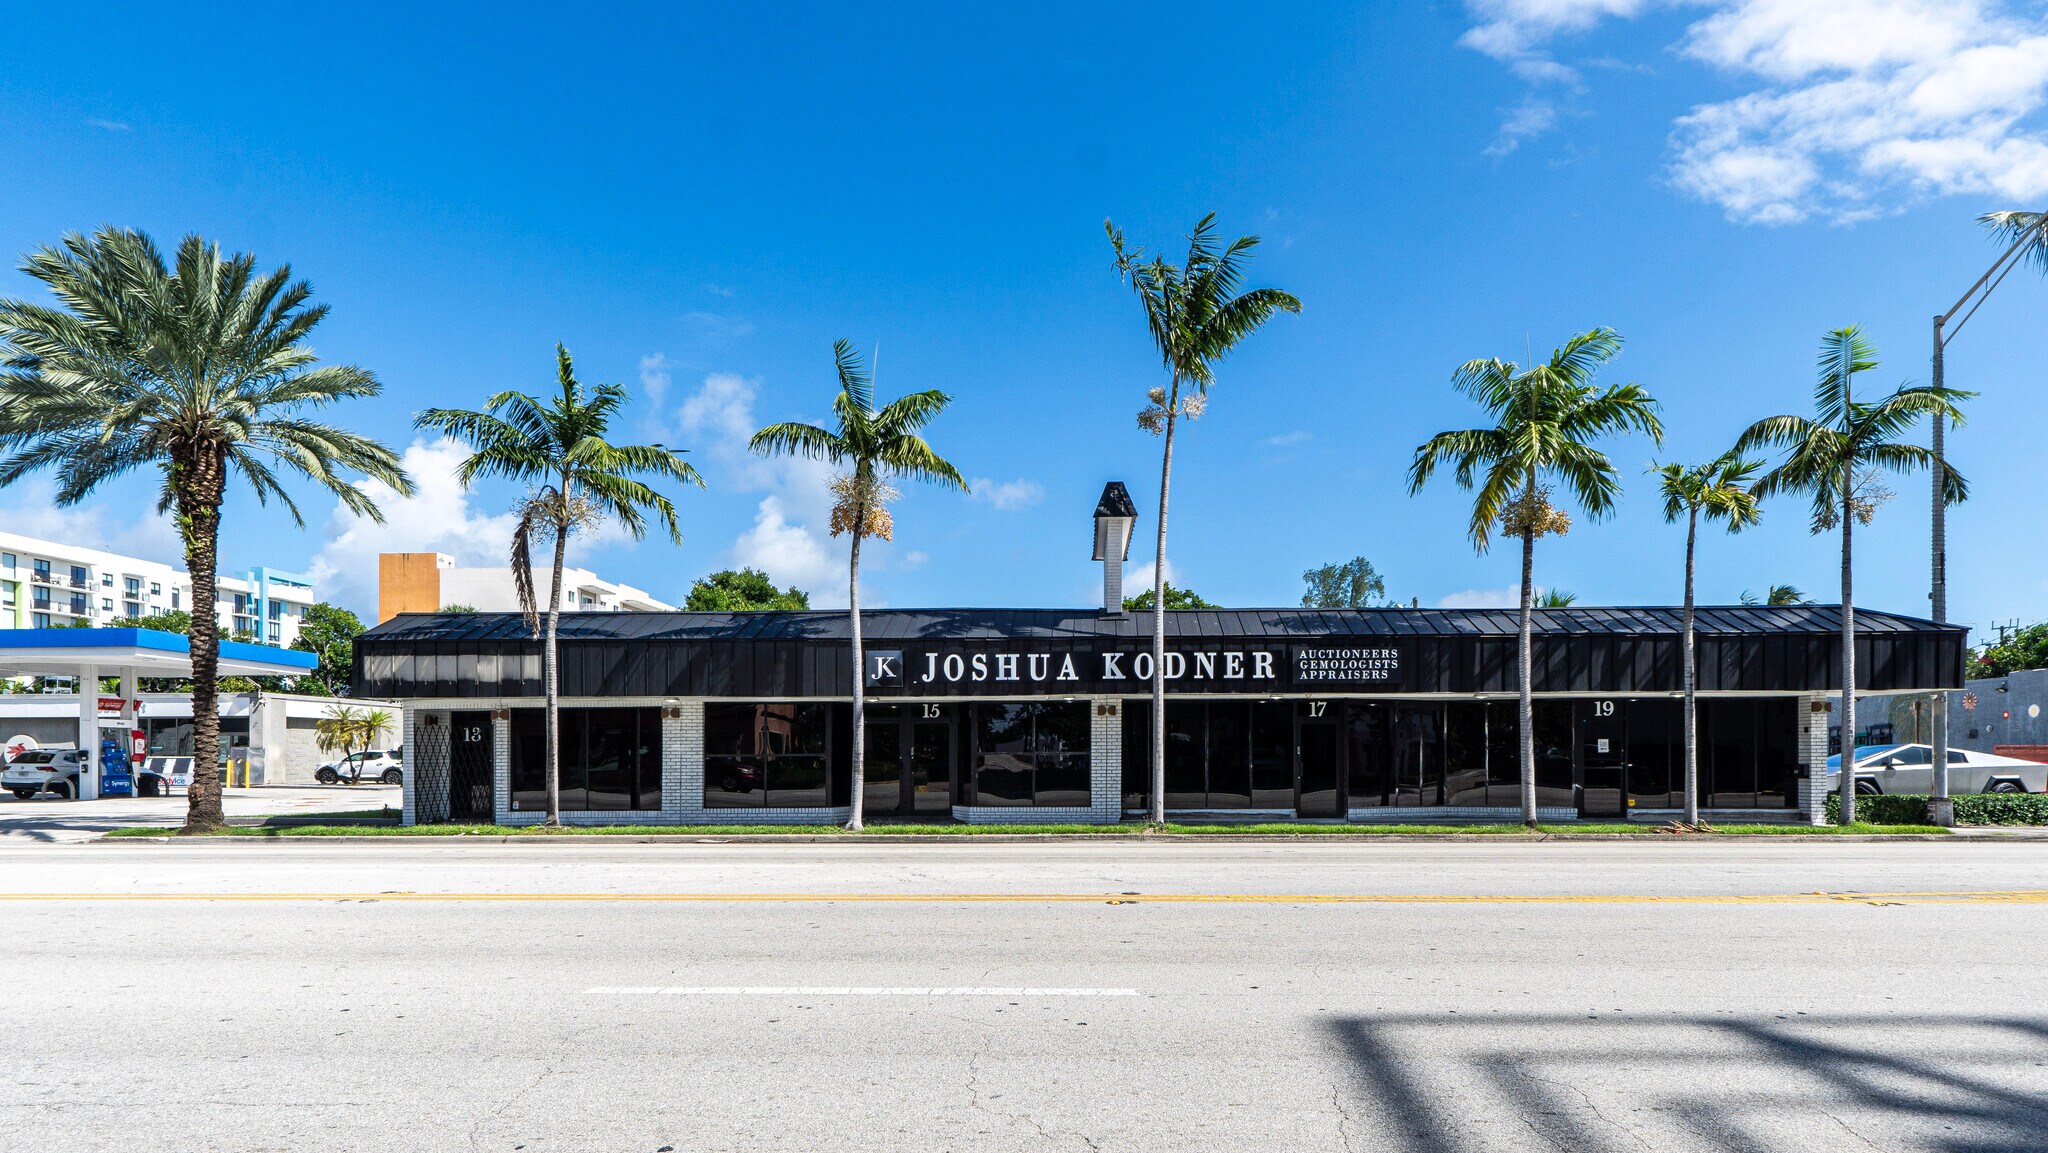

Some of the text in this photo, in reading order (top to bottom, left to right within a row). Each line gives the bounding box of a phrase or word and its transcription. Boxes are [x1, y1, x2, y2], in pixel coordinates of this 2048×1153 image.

[1299, 649, 1398, 659] AUCTIONEERS
[871, 656, 897, 680] JK
[921, 652, 1276, 682] JOSHUA KODNER
[1300, 660, 1399, 670] GEMOLOGISTS
[1300, 670, 1389, 680] APPRAISERS
[922, 703, 941, 719] 15
[1309, 701, 1327, 717] 17
[1594, 700, 1615, 717] 19
[463, 726, 482, 742] 13
[111, 780, 131, 788] Synergy
